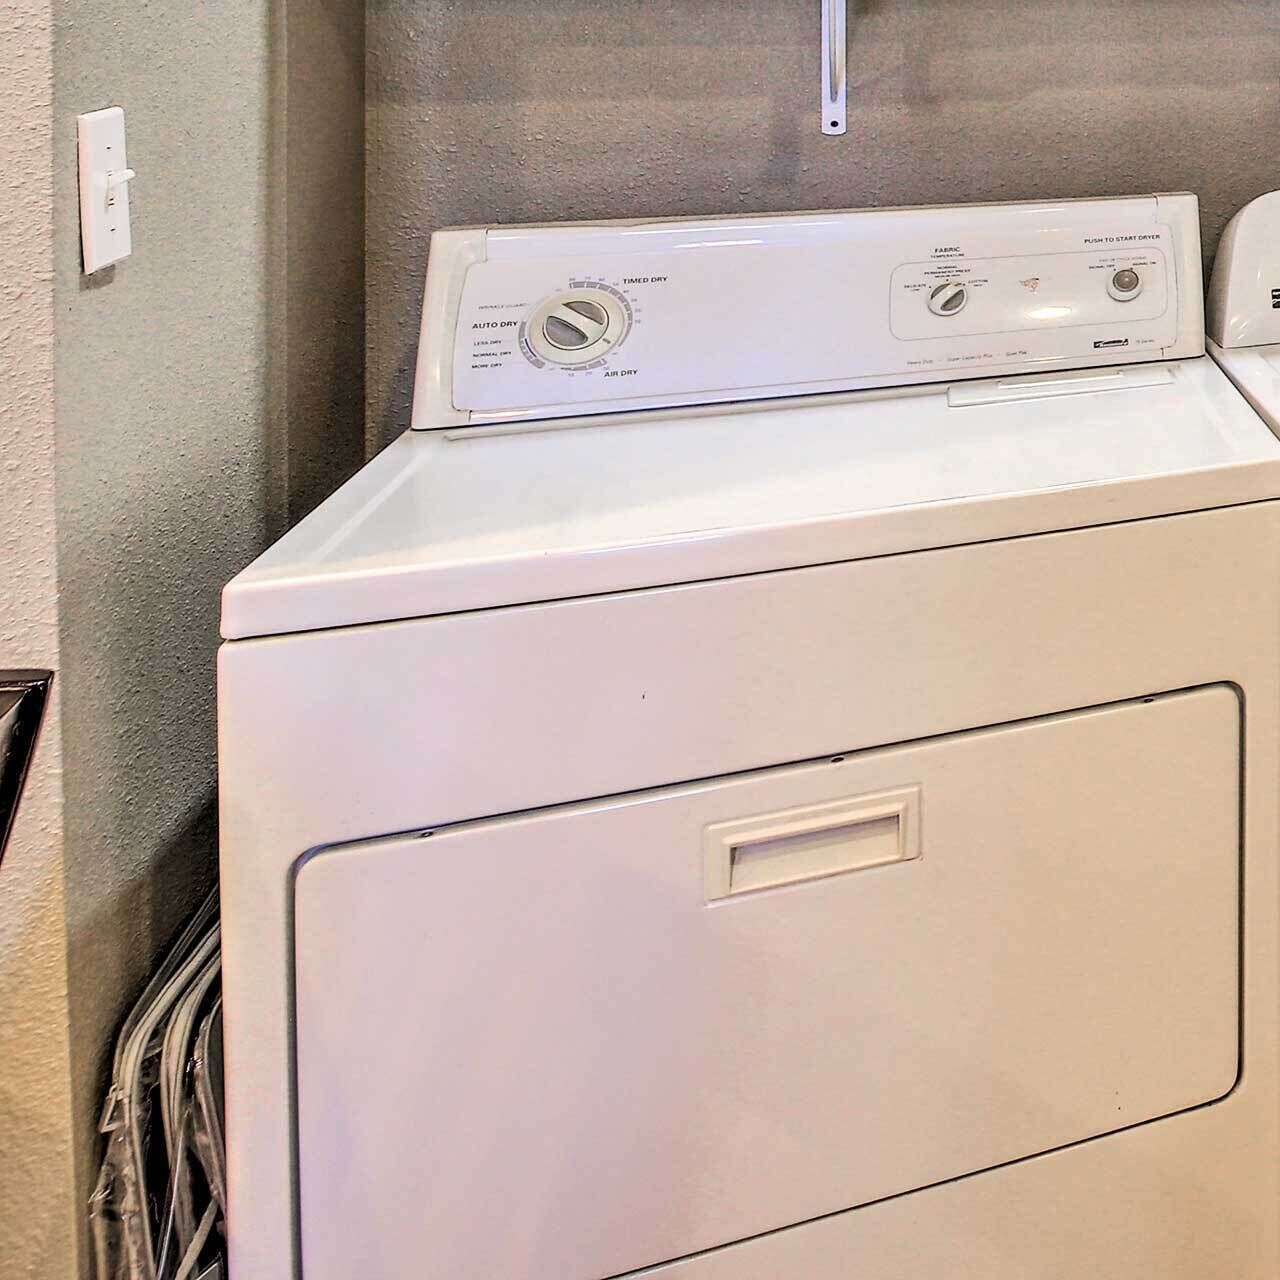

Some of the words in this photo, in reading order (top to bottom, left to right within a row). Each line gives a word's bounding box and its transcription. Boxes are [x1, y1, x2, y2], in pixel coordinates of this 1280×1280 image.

[623, 277, 648, 285] TIMED
[472, 322, 498, 330] AUTO
[500, 320, 519, 328] DRY
[604, 370, 617, 378] AIR
